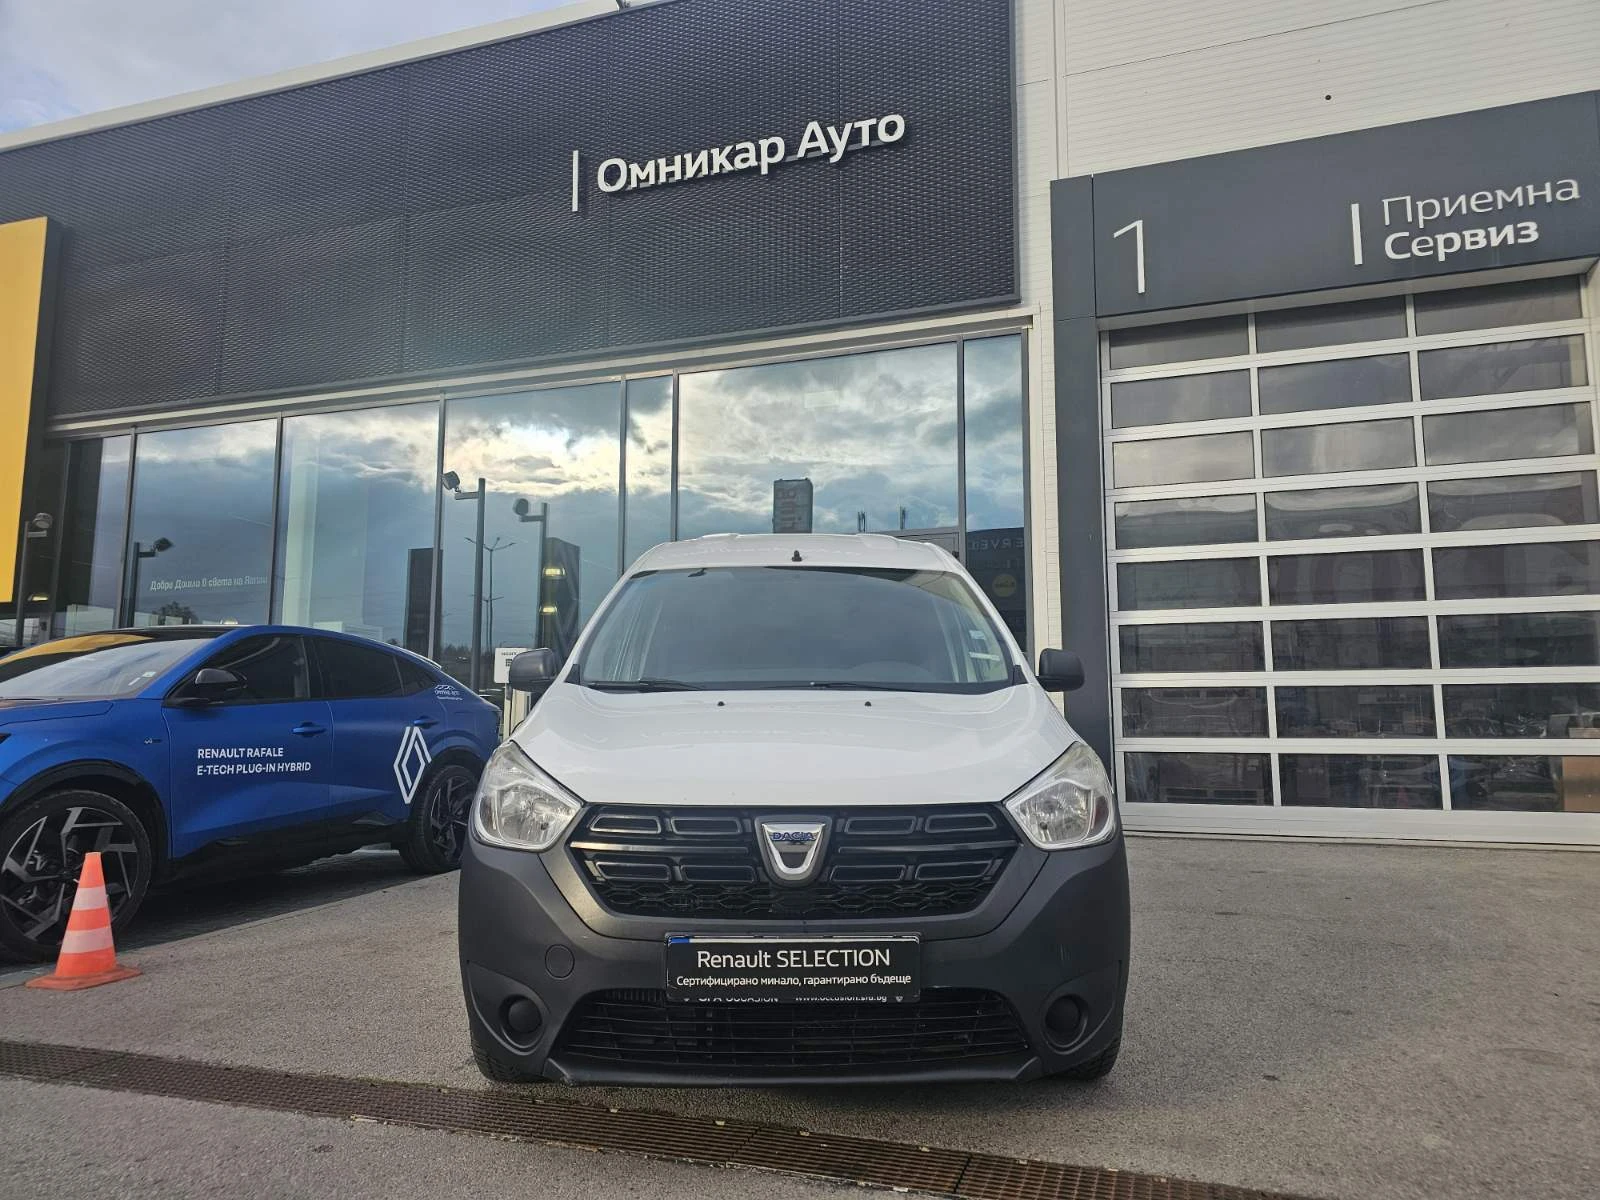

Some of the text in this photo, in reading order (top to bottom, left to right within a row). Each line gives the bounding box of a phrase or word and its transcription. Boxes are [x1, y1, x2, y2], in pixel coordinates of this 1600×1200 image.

[598, 113, 906, 193] Омникар Ауто
[1382, 178, 1580, 228] Приемна
[1384, 219, 1540, 262] Сервиз
[1113, 219, 1145, 294] 1
[198, 747, 284, 758] RENAULT RAFALE
[197, 761, 311, 775] E-TECH PLUG-IN HYBRID
[772, 831, 816, 841] DACIA
[697, 948, 890, 968] Renault SELECTION
[676, 973, 911, 987] Сертифицирано минало, гарантирано бъдеще
